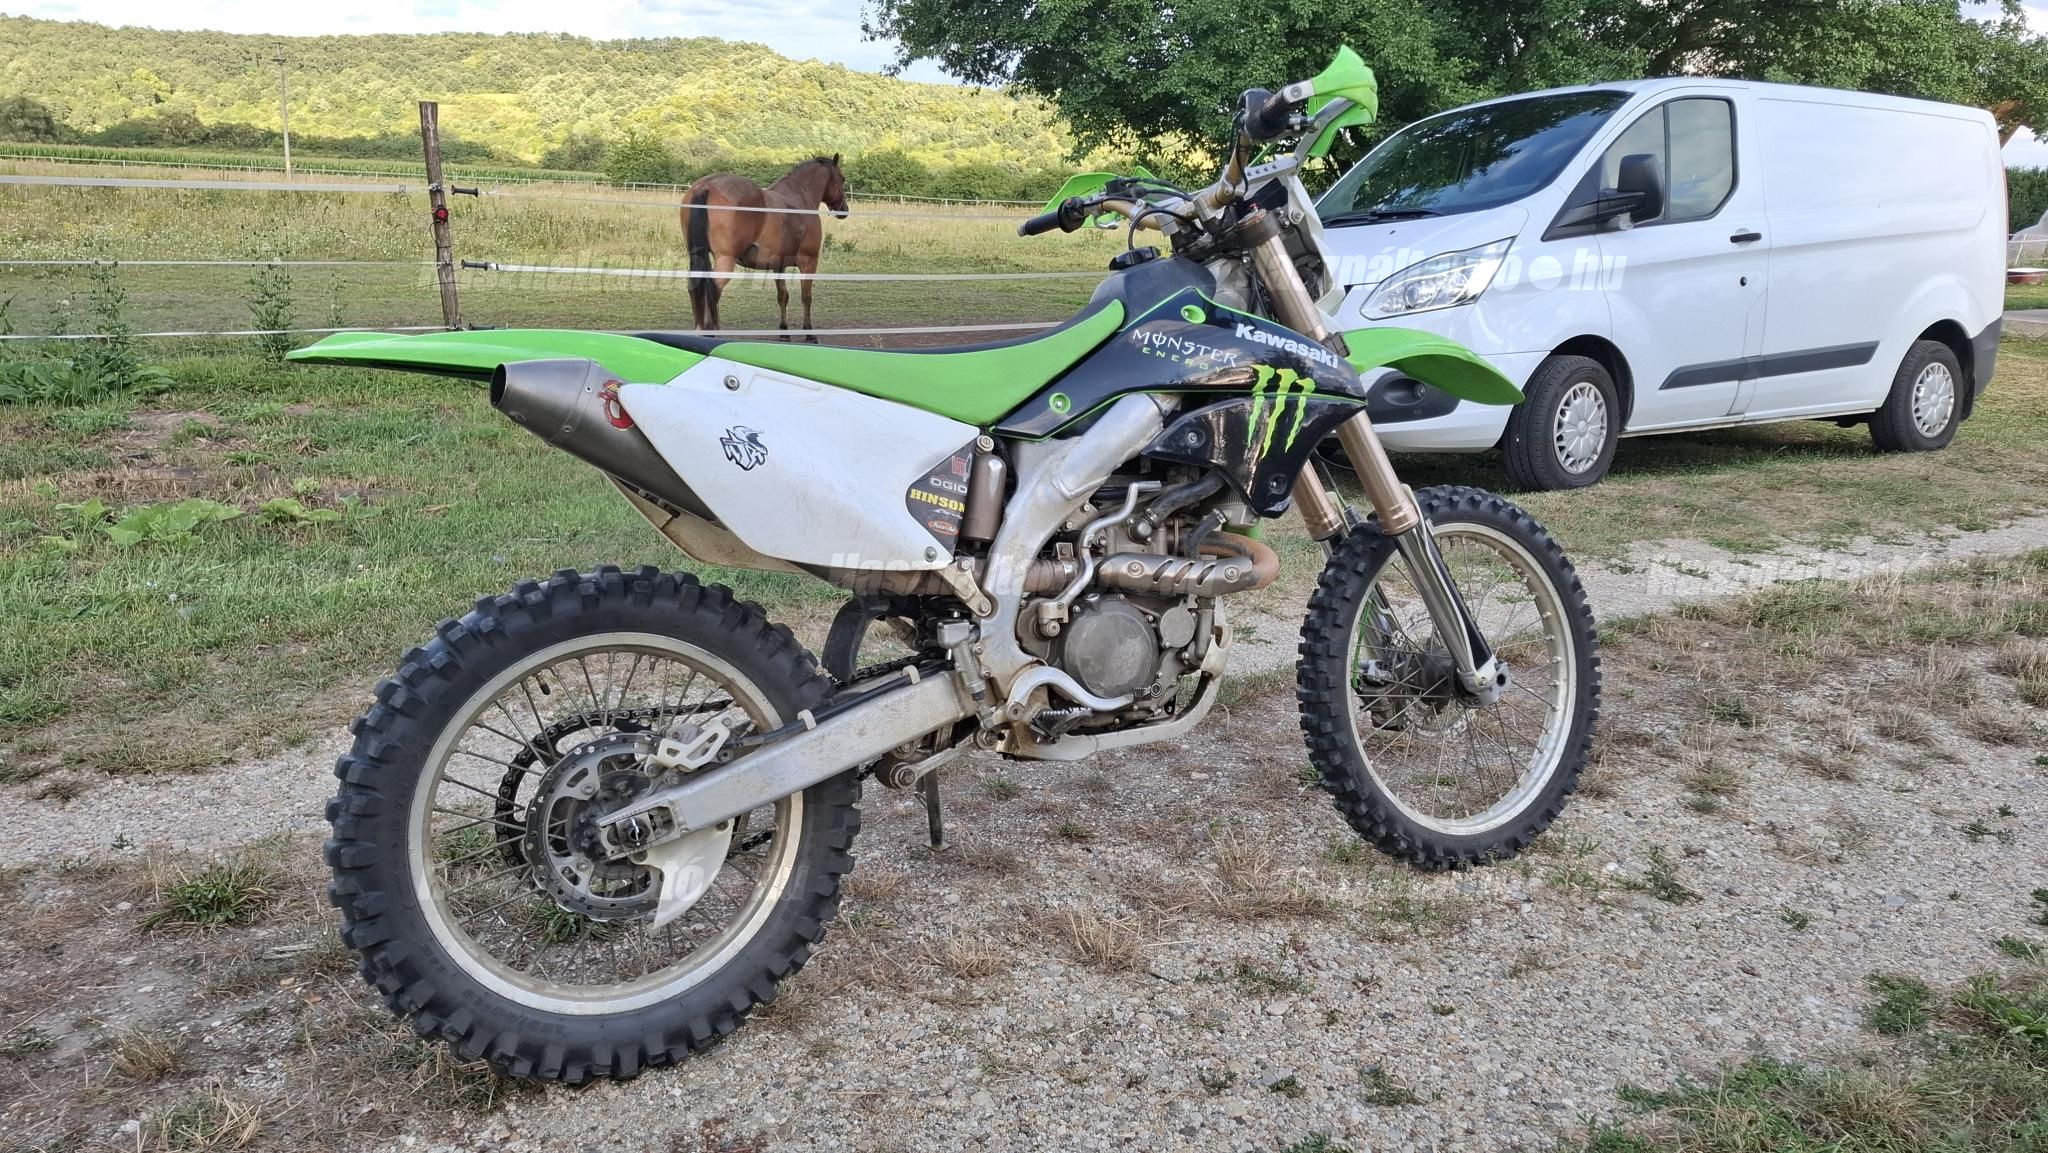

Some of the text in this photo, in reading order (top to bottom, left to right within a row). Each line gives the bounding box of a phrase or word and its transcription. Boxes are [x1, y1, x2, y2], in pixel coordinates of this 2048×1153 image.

[1235, 322, 1339, 369] Kawasaki
[1142, 346, 1224, 374] ENERGY
[930, 476, 968, 494] OGIO
[910, 488, 966, 513] HINSON
